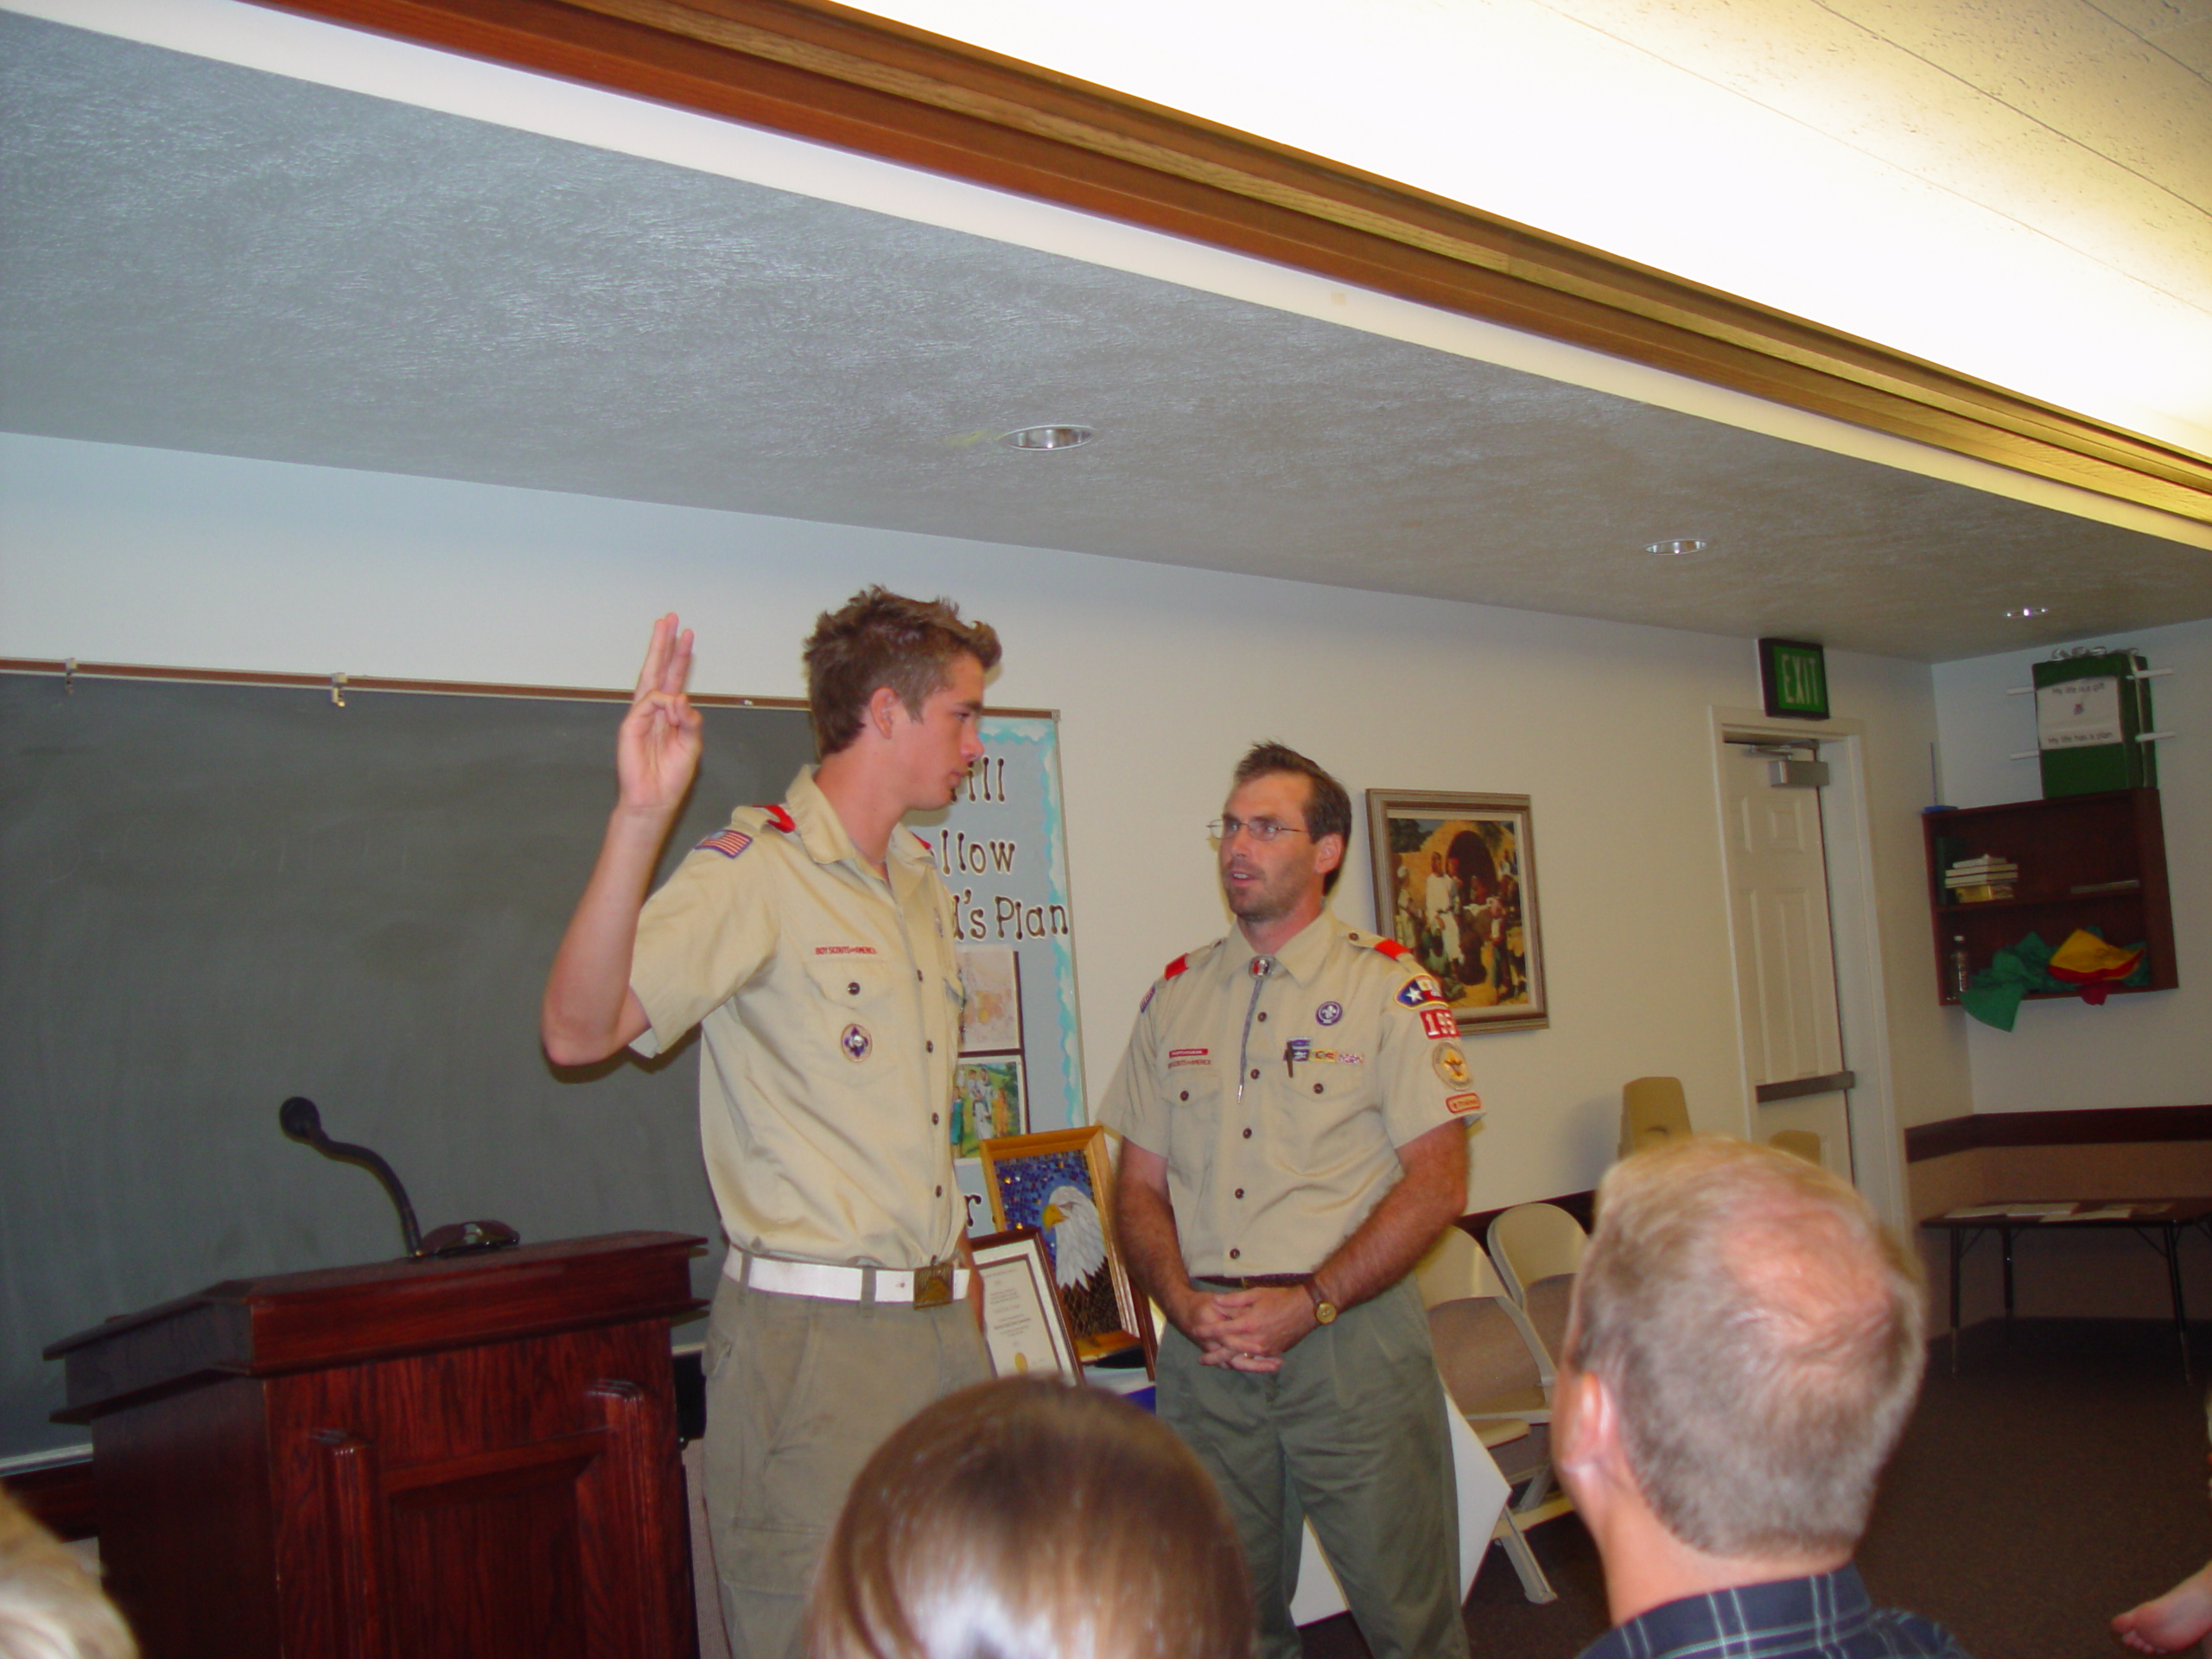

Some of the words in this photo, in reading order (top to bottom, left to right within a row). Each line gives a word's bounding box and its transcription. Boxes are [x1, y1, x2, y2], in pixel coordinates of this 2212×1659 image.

[1781, 654, 1819, 706] EXIT
[933, 830, 1015, 875] llow
[995, 895, 1069, 941] Plan
